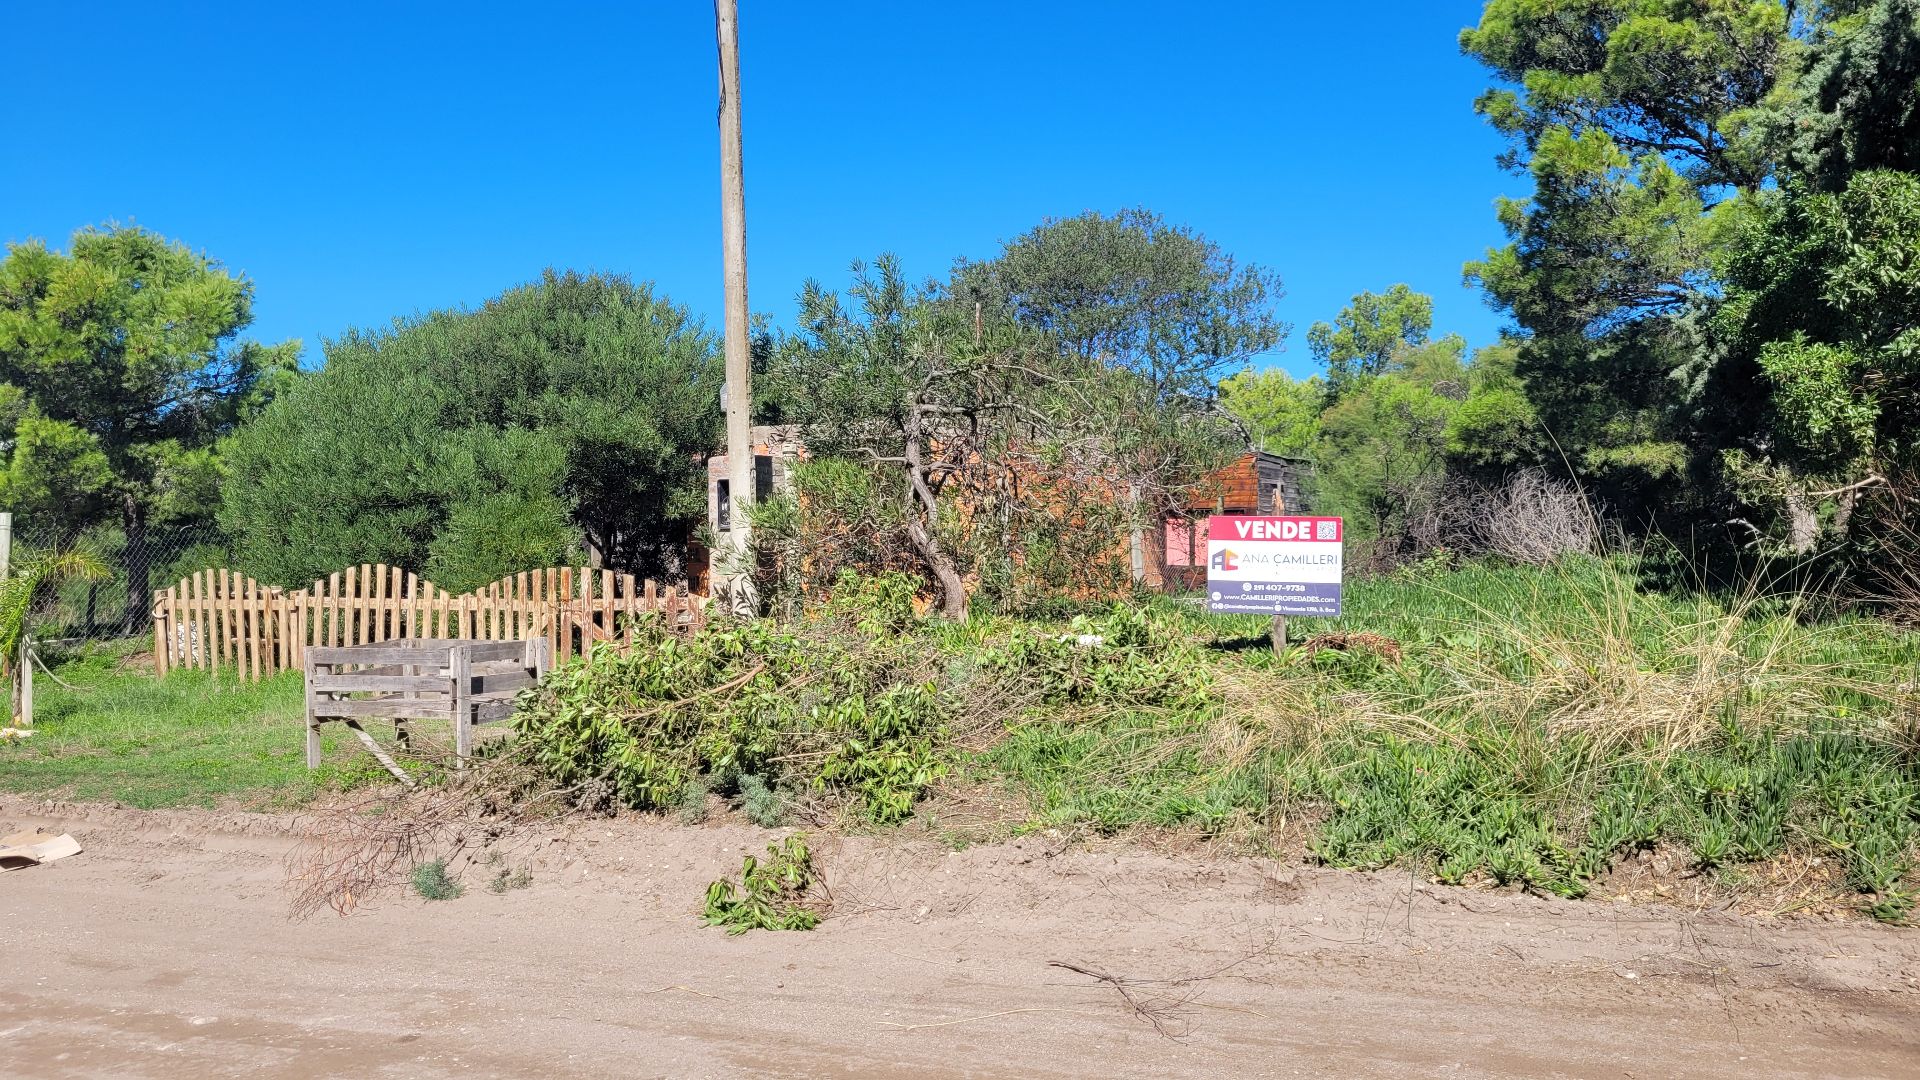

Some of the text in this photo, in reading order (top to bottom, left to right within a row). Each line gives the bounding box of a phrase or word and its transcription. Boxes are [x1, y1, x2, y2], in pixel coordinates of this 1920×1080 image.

[1234, 520, 1311, 539] VENDE
[1242, 553, 1338, 565] ANA CAMILLERI
[1265, 584, 1306, 592] 407-9738
[1223, 594, 1336, 603] www.CAMILLERIPROPIEDADES.com
